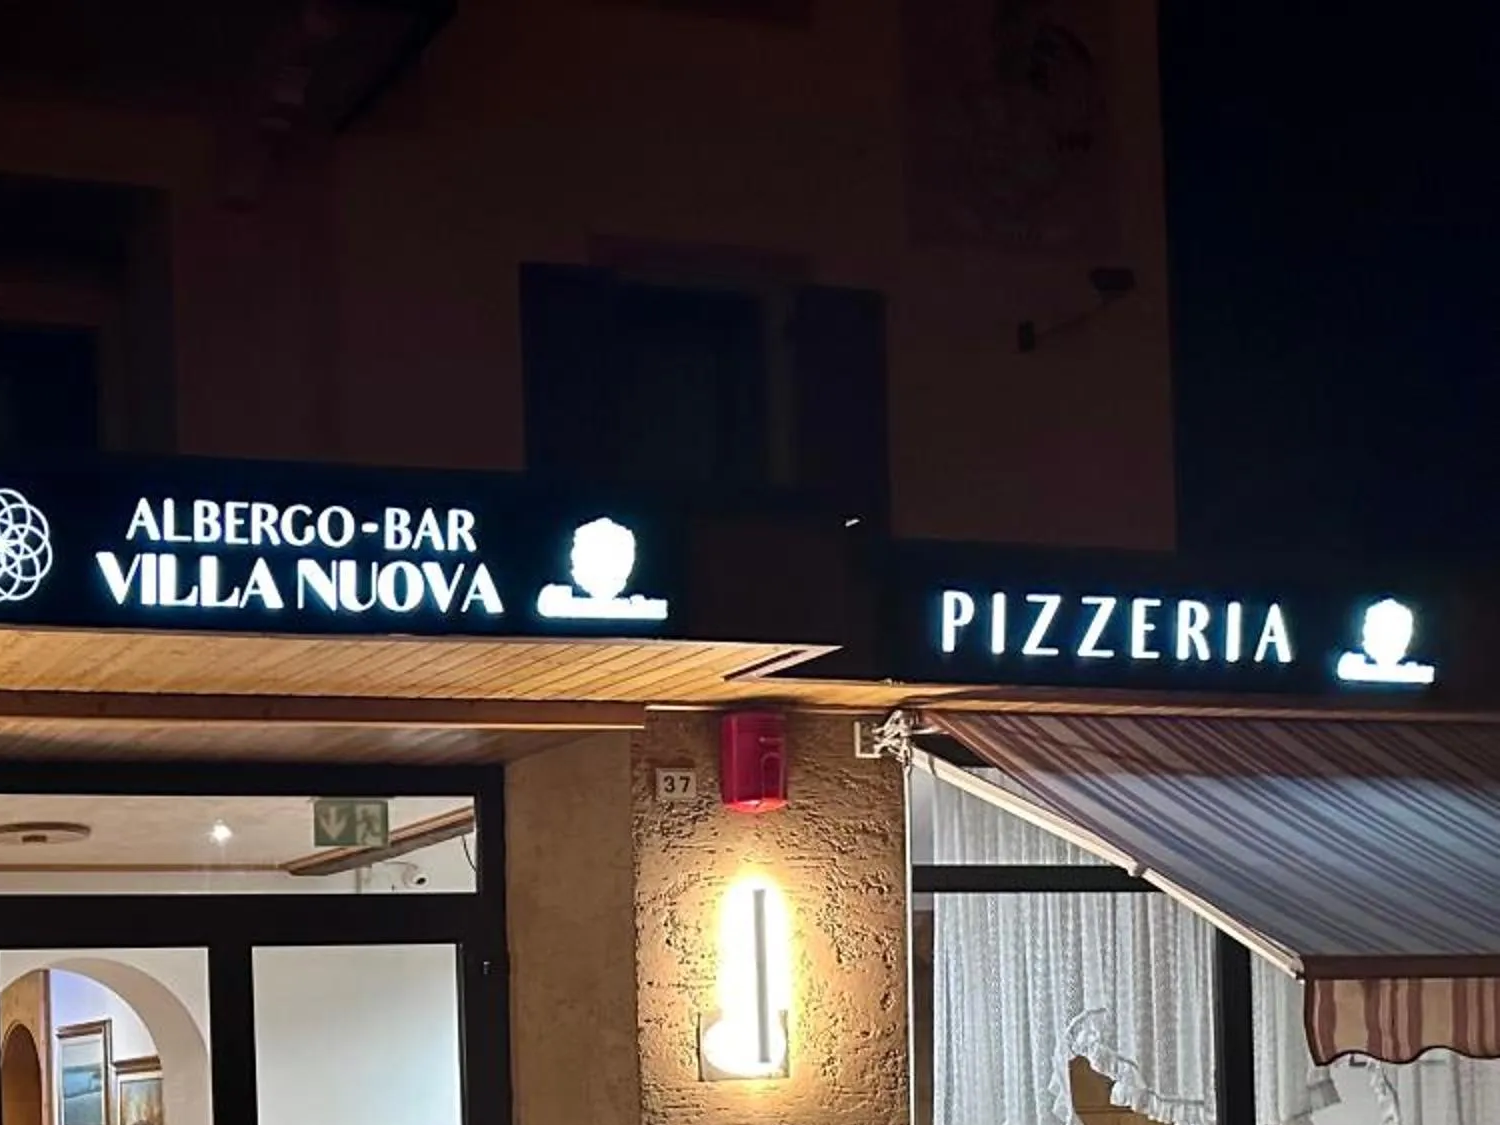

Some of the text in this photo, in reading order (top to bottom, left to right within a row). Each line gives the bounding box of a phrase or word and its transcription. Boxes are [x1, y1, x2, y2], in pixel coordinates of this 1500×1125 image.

[125, 497, 477, 553] ALBERGO-BAR
[95, 551, 505, 614] VILLA NUOVA
[941, 590, 1292, 664] PIZZERIA
[663, 775, 691, 793] 37
